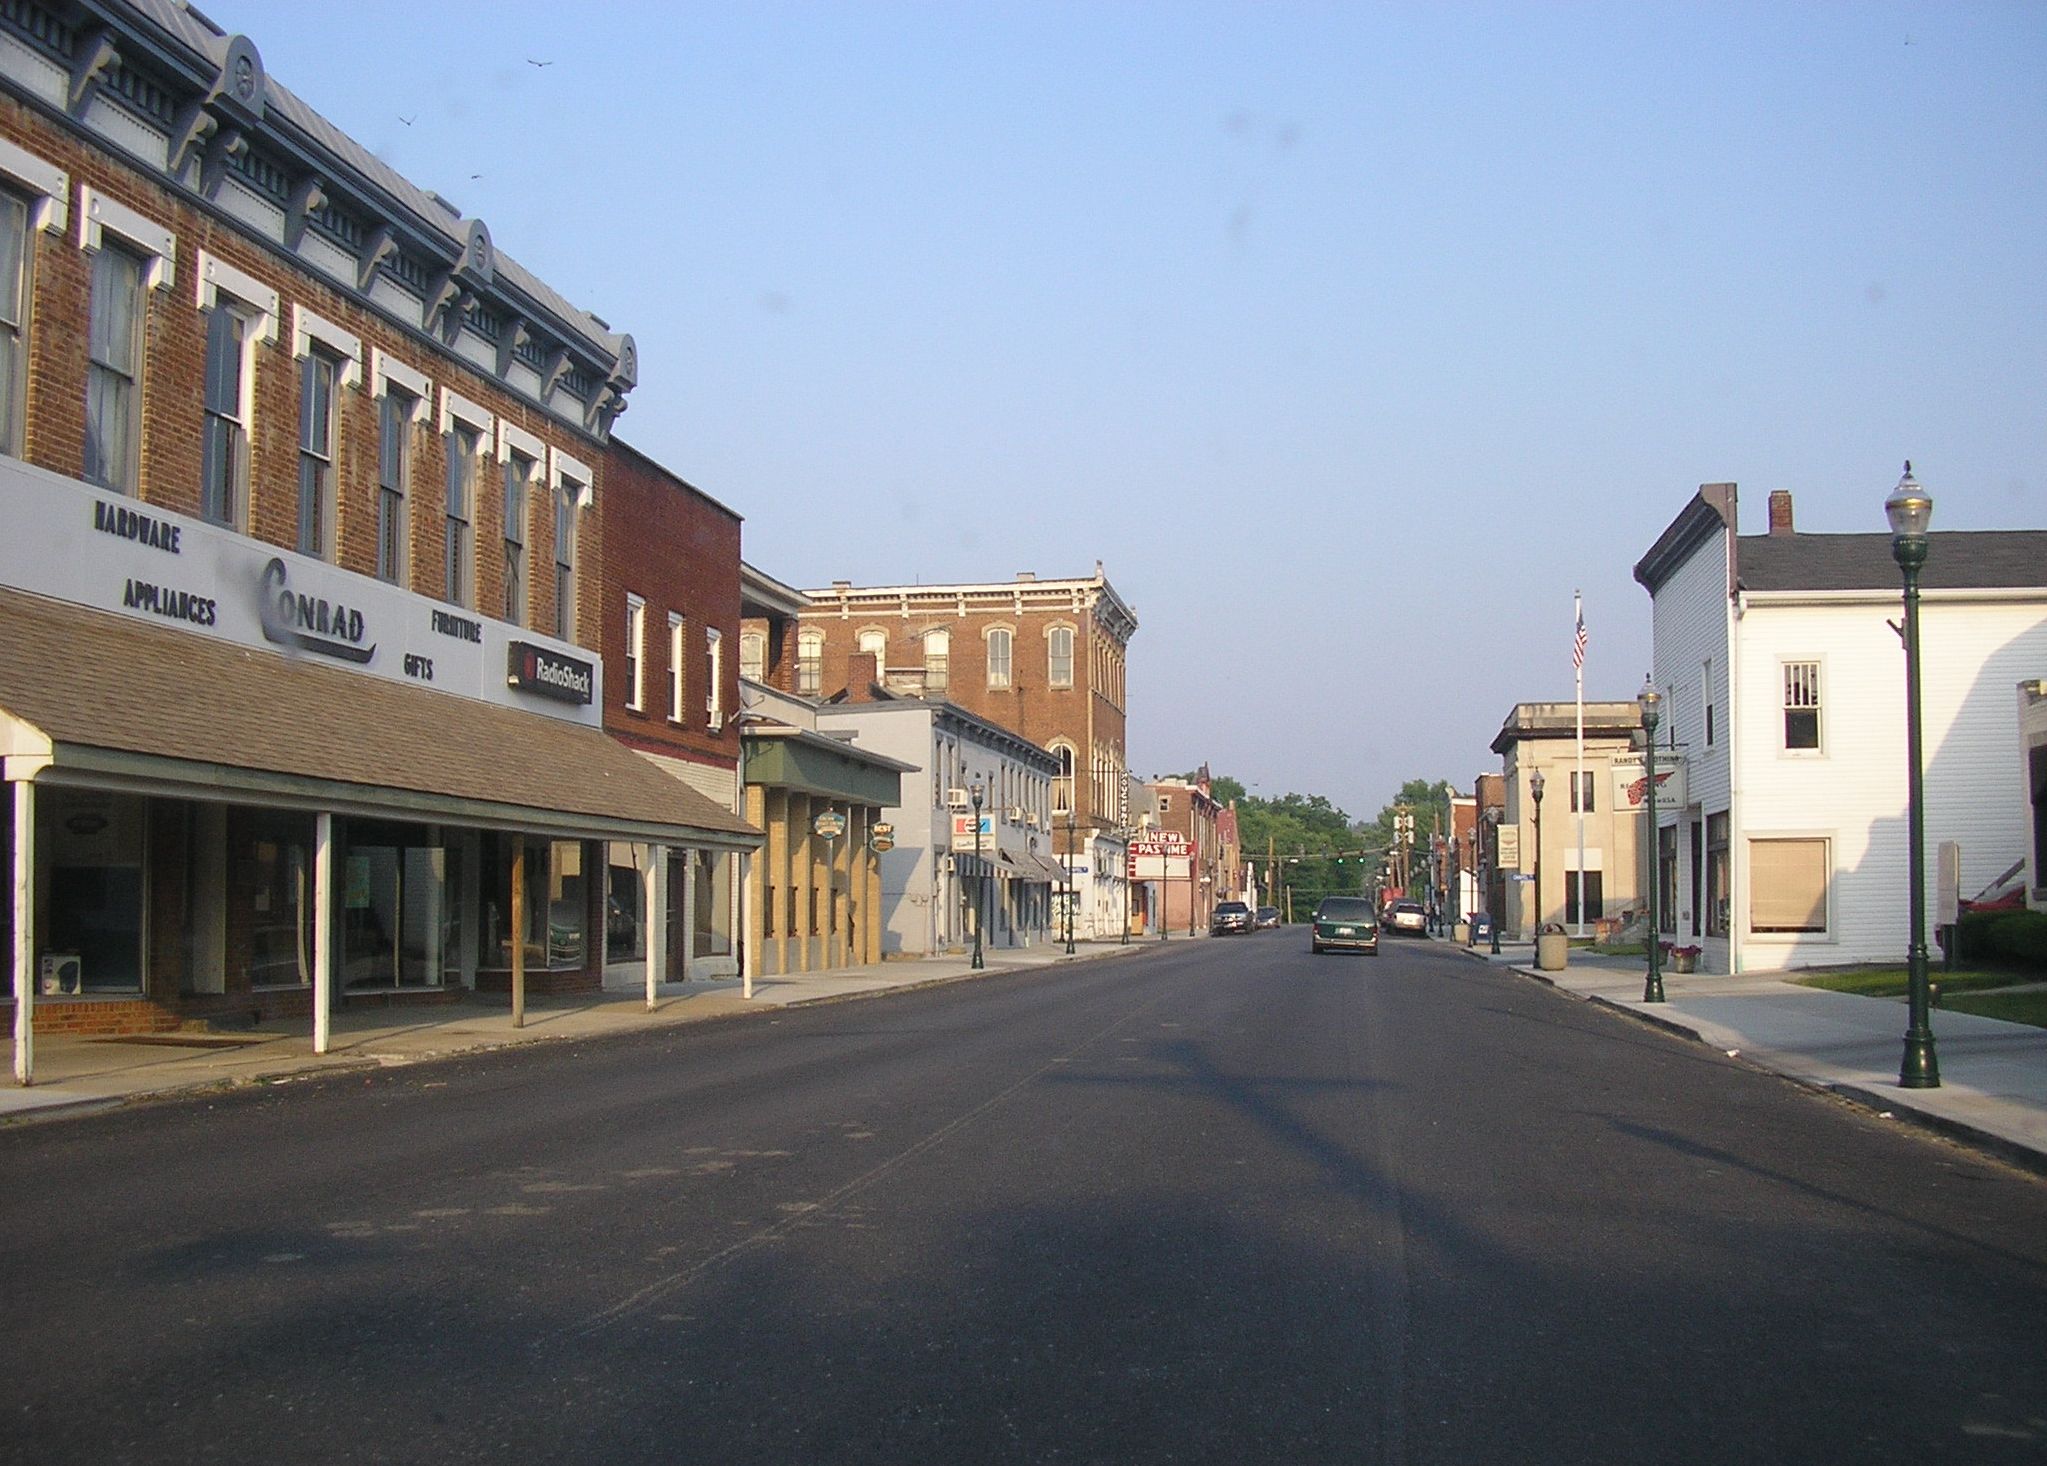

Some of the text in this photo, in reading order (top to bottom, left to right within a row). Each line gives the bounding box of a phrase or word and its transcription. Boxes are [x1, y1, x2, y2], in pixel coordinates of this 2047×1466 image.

[94, 500, 181, 554] HARDWARE
[123, 578, 216, 627] APPLIANCES
[431, 609, 482, 644] FURNITURE
[404, 653, 434, 681] GIFTS
[536, 656, 591, 694] RadioShack
[1138, 844, 1187, 855] PASIME
[1150, 832, 1178, 842] NEW
